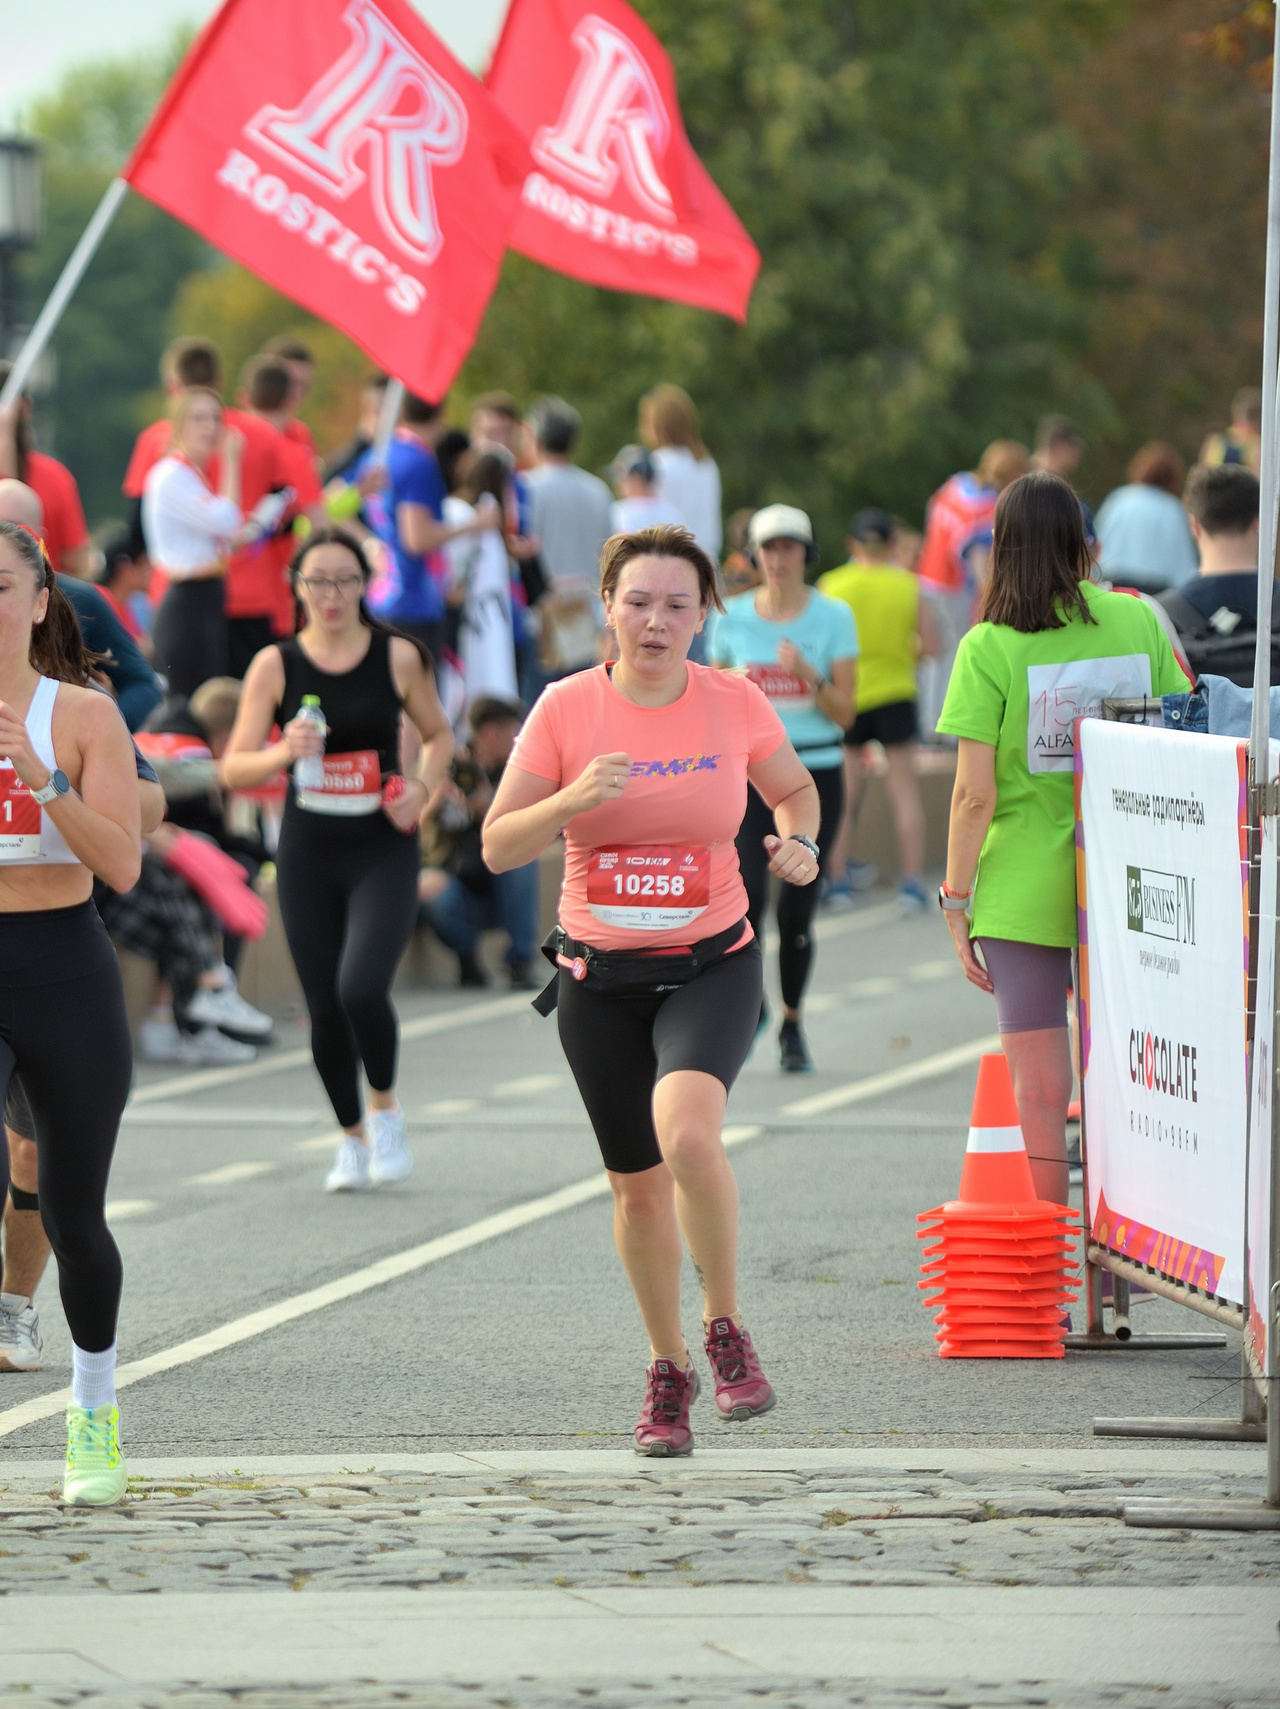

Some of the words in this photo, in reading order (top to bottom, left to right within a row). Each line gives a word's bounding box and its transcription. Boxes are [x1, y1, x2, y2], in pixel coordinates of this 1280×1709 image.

[242, 0, 468, 267] R
[216, 148, 427, 316] ROSTIC'S
[1035, 686, 1078, 728] 15
[614, 873, 685, 896] 10258
[1143, 884, 1175, 925] BUSINESS
[1129, 1027, 1198, 1104] CHOCOLATE
